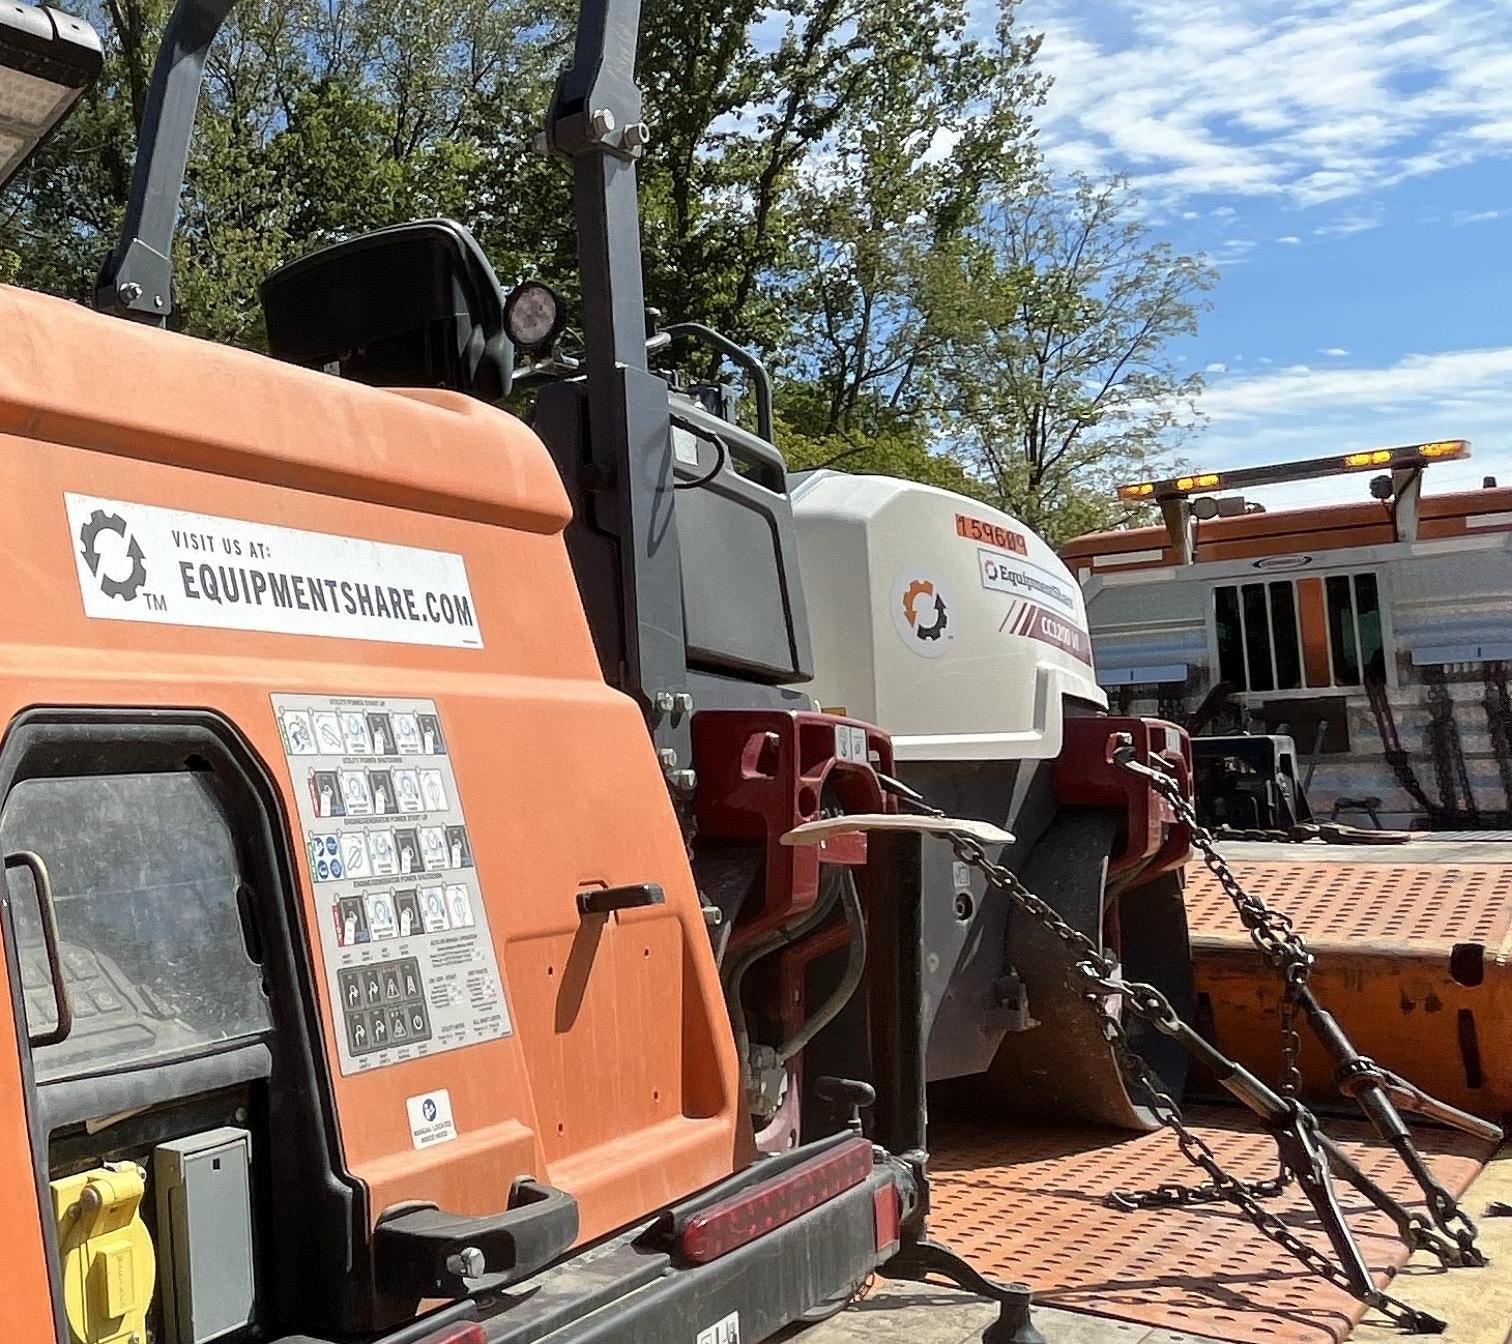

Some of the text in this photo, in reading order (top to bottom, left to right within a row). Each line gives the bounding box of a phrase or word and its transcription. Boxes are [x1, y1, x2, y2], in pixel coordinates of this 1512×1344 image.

[171, 529, 272, 559] VISIT US AT:
[956, 515, 1027, 555] 159609
[143, 592, 168, 612] TM
[178, 560, 474, 627] EQUIPMENTSHARE.COM
